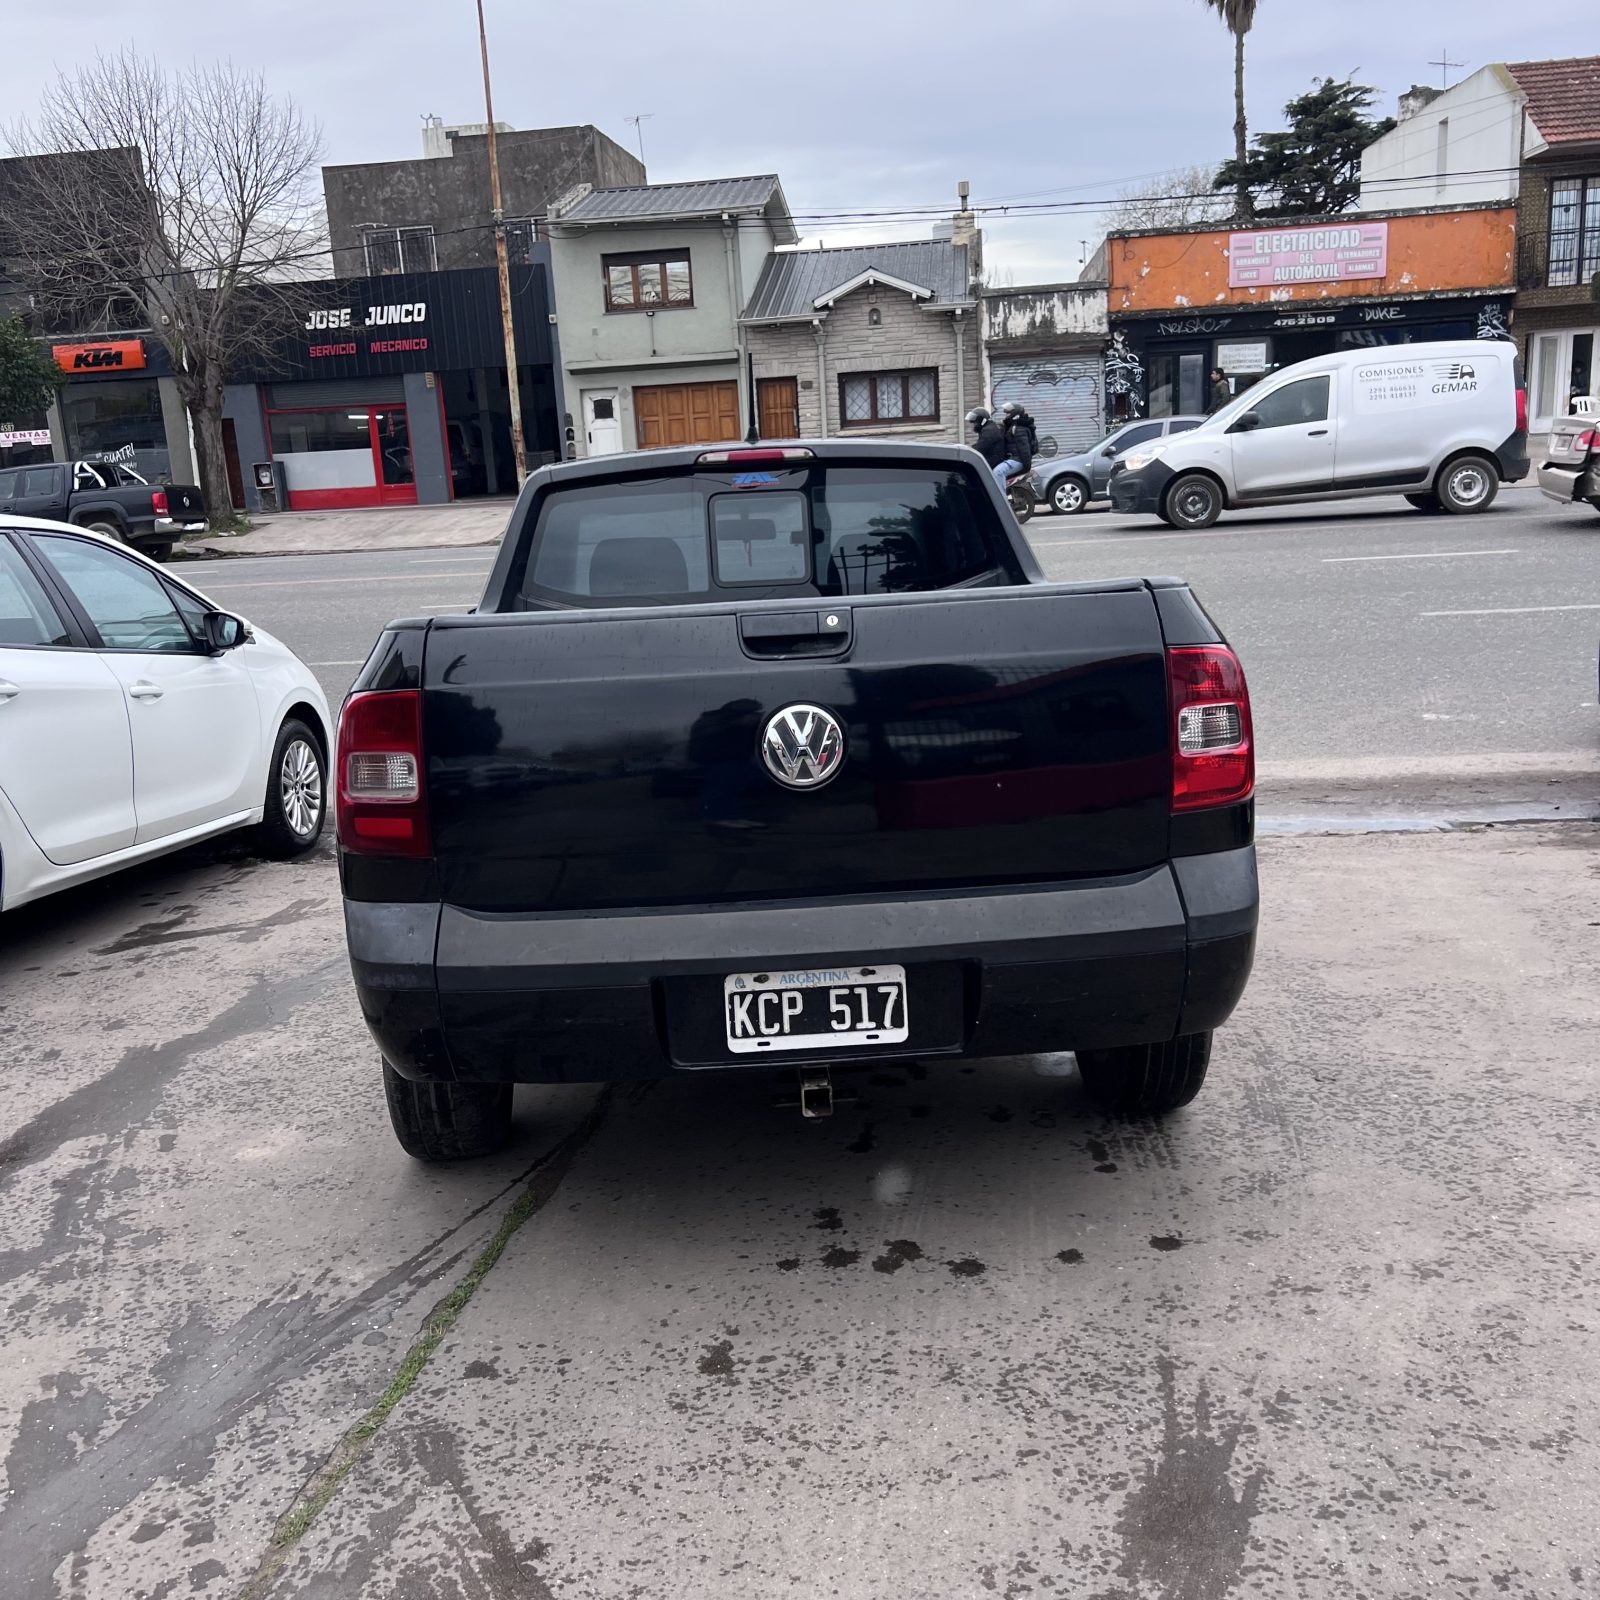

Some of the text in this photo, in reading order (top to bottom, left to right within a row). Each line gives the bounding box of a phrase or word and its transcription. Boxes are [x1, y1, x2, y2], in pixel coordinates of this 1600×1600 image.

[1254, 229, 1361, 254] ELECTRICIDAD
[1235, 256, 1270, 266] ARRANQUES
[1299, 252, 1314, 264] DEL
[1336, 249, 1380, 259] ALTERNADORES
[1239, 270, 1257, 279] LUCES
[1273, 263, 1340, 282] AUTOMOVIL
[1348, 263, 1375, 272] ALARMAS
[305, 302, 427, 330] JOSE JUNCO
[308, 338, 428, 358] SERVICIO MECANICO
[73, 347, 124, 369] KTM
[1359, 365, 1425, 379] COMISIONES
[1431, 381, 1478, 394] GEMAR
[4, 430, 48, 439] VENTAS
[779, 970, 850, 985] ARGENTINA
[733, 985, 899, 1037] KCP 517
